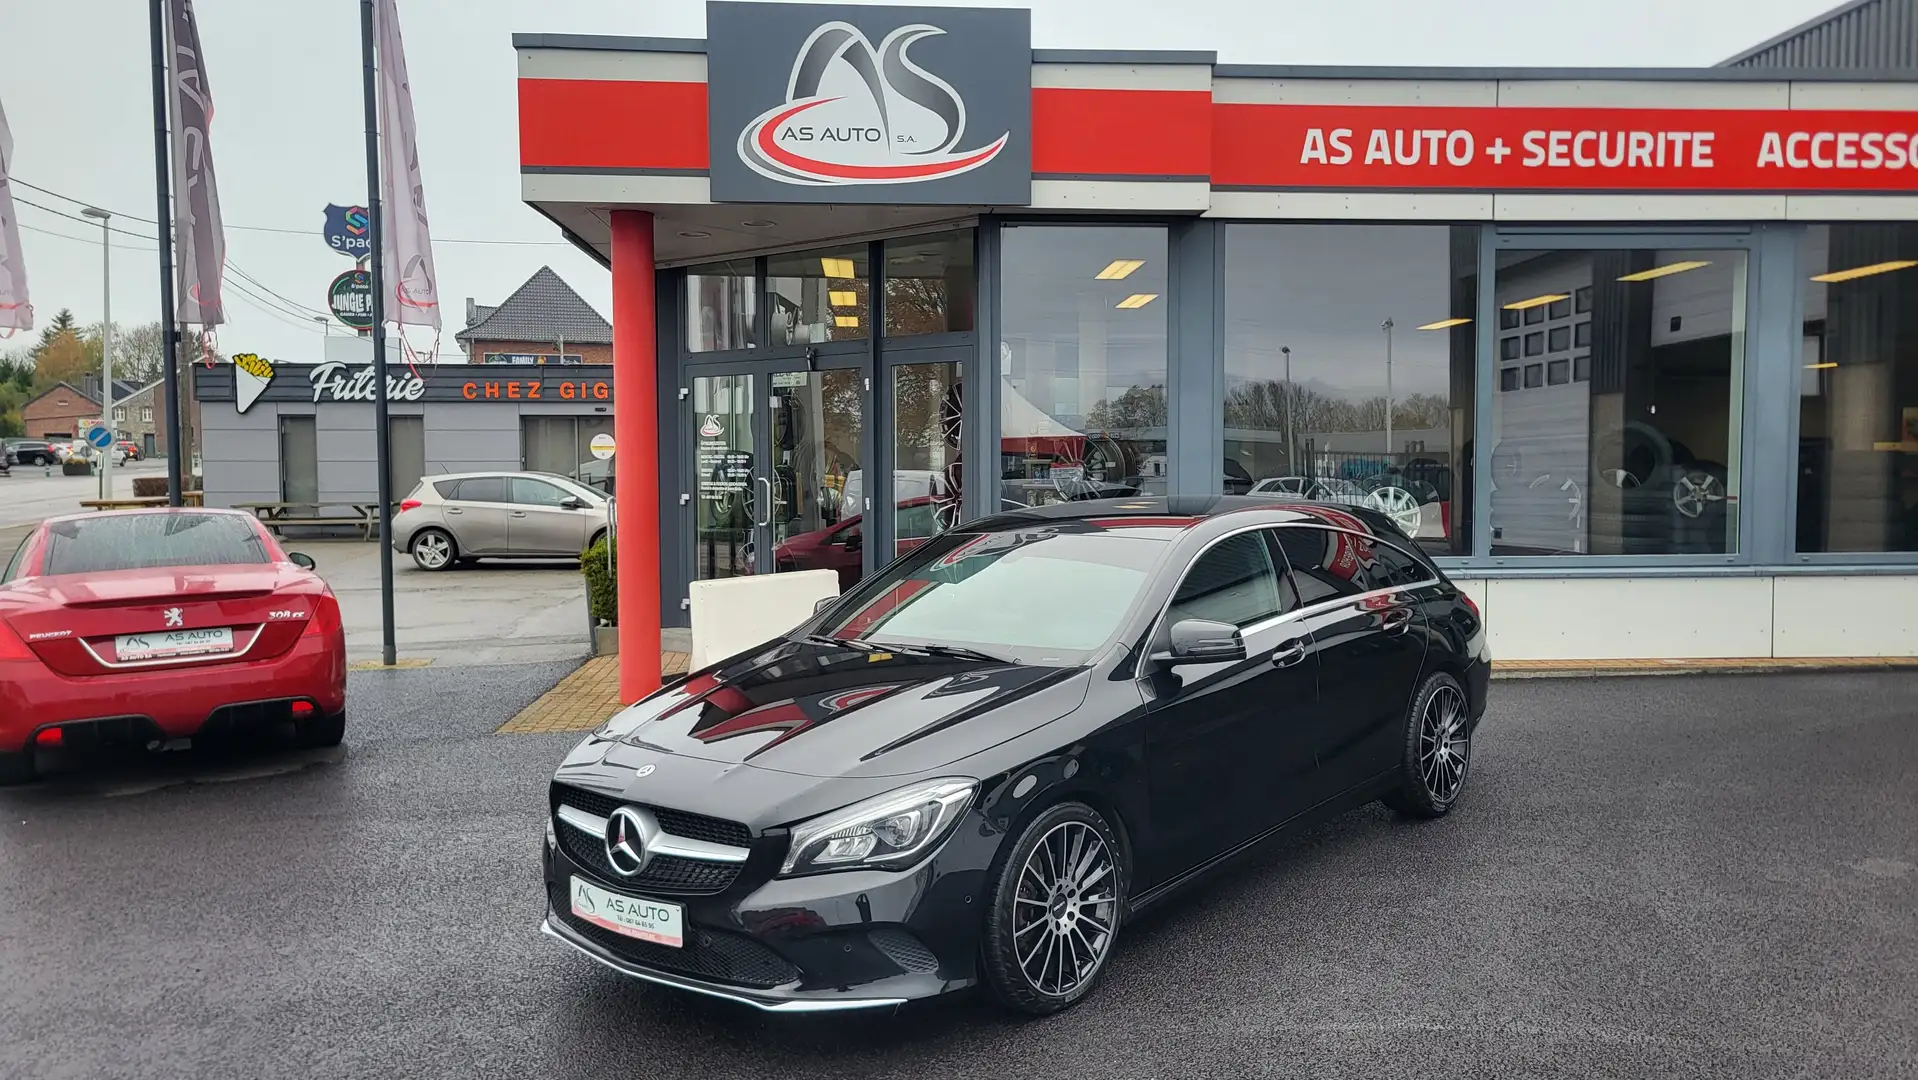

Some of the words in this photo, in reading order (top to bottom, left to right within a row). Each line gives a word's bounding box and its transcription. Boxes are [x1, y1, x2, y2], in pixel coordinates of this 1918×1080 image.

[781, 127, 814, 141] AS
[820, 127, 881, 142] AUTO
[896, 135, 918, 143] S.A.
[1300, 128, 1353, 165] AS
[1364, 129, 1474, 167] AUTO
[1485, 138, 1511, 164] +
[1522, 130, 1714, 168] SECURITE
[331, 236, 371, 250] S'pac
[332, 292, 364, 314] JUNGLE
[366, 293, 373, 312] P
[511, 355, 534, 365] FAMILY
[462, 382, 541, 399] CHEZ
[268, 610, 291, 620] 308
[165, 633, 184, 642] AS
[188, 630, 223, 640] AUTO
[606, 898, 625, 913] AS
[628, 903, 670, 922] AUTO
